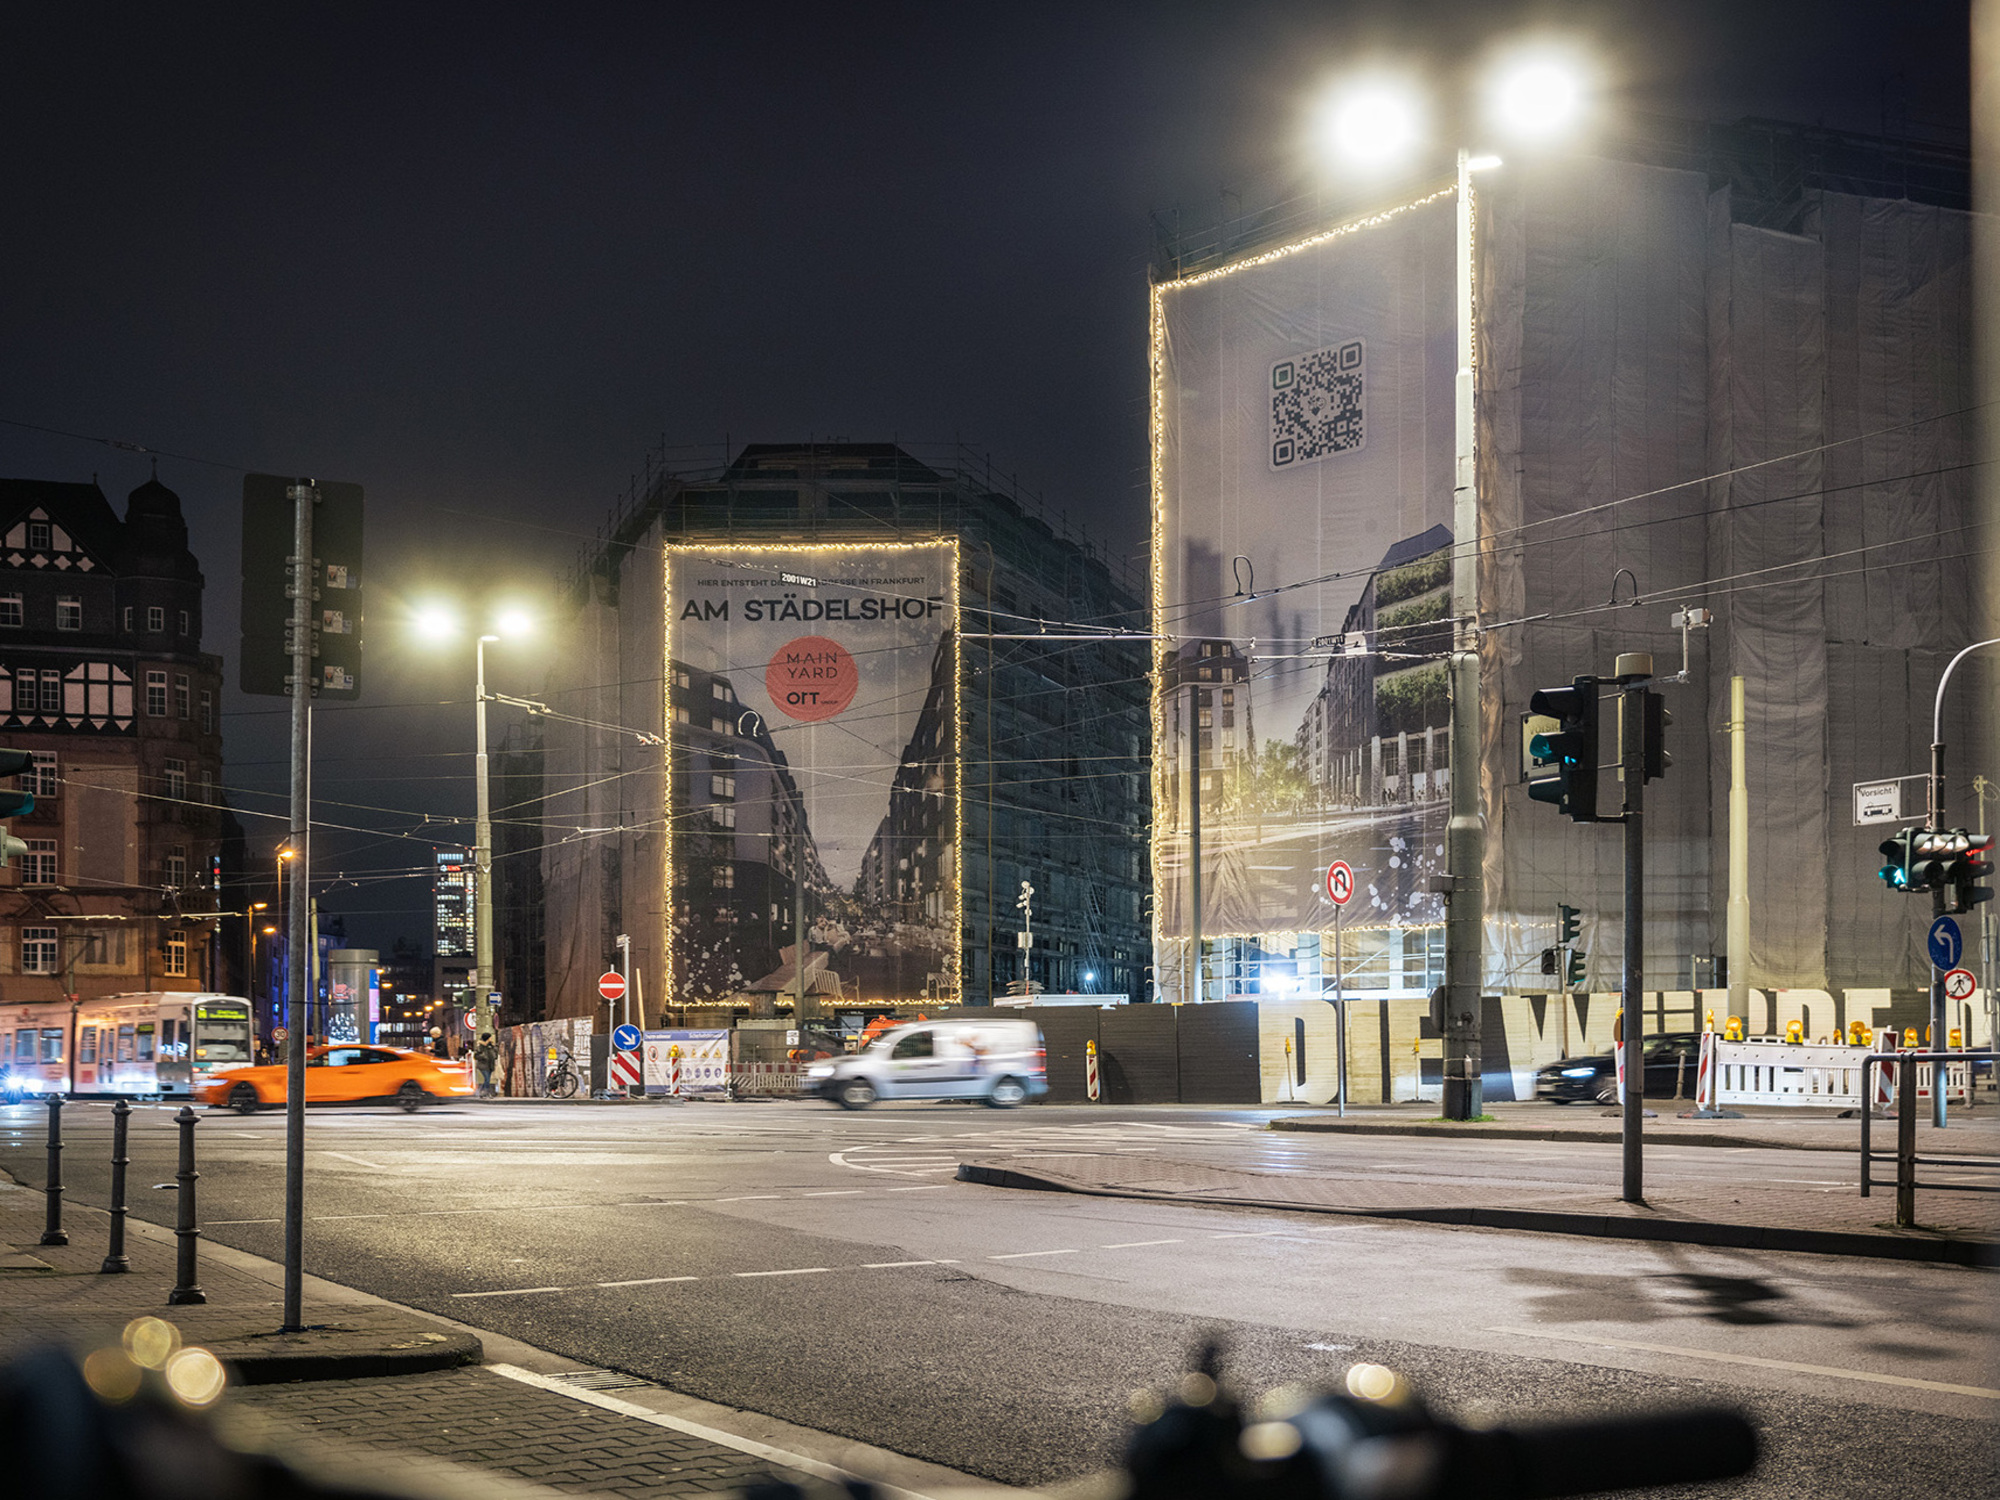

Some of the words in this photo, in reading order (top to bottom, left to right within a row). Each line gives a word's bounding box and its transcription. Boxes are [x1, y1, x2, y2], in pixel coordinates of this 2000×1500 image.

[697, 579, 718, 587] HIER
[720, 579, 768, 587] ENTSTEHT
[870, 576, 926, 586] FRANKFURT
[680, 599, 729, 621] AM
[743, 592, 944, 621] STÄDELSHOF
[786, 652, 837, 664] MAIN
[787, 666, 838, 679] YARD
